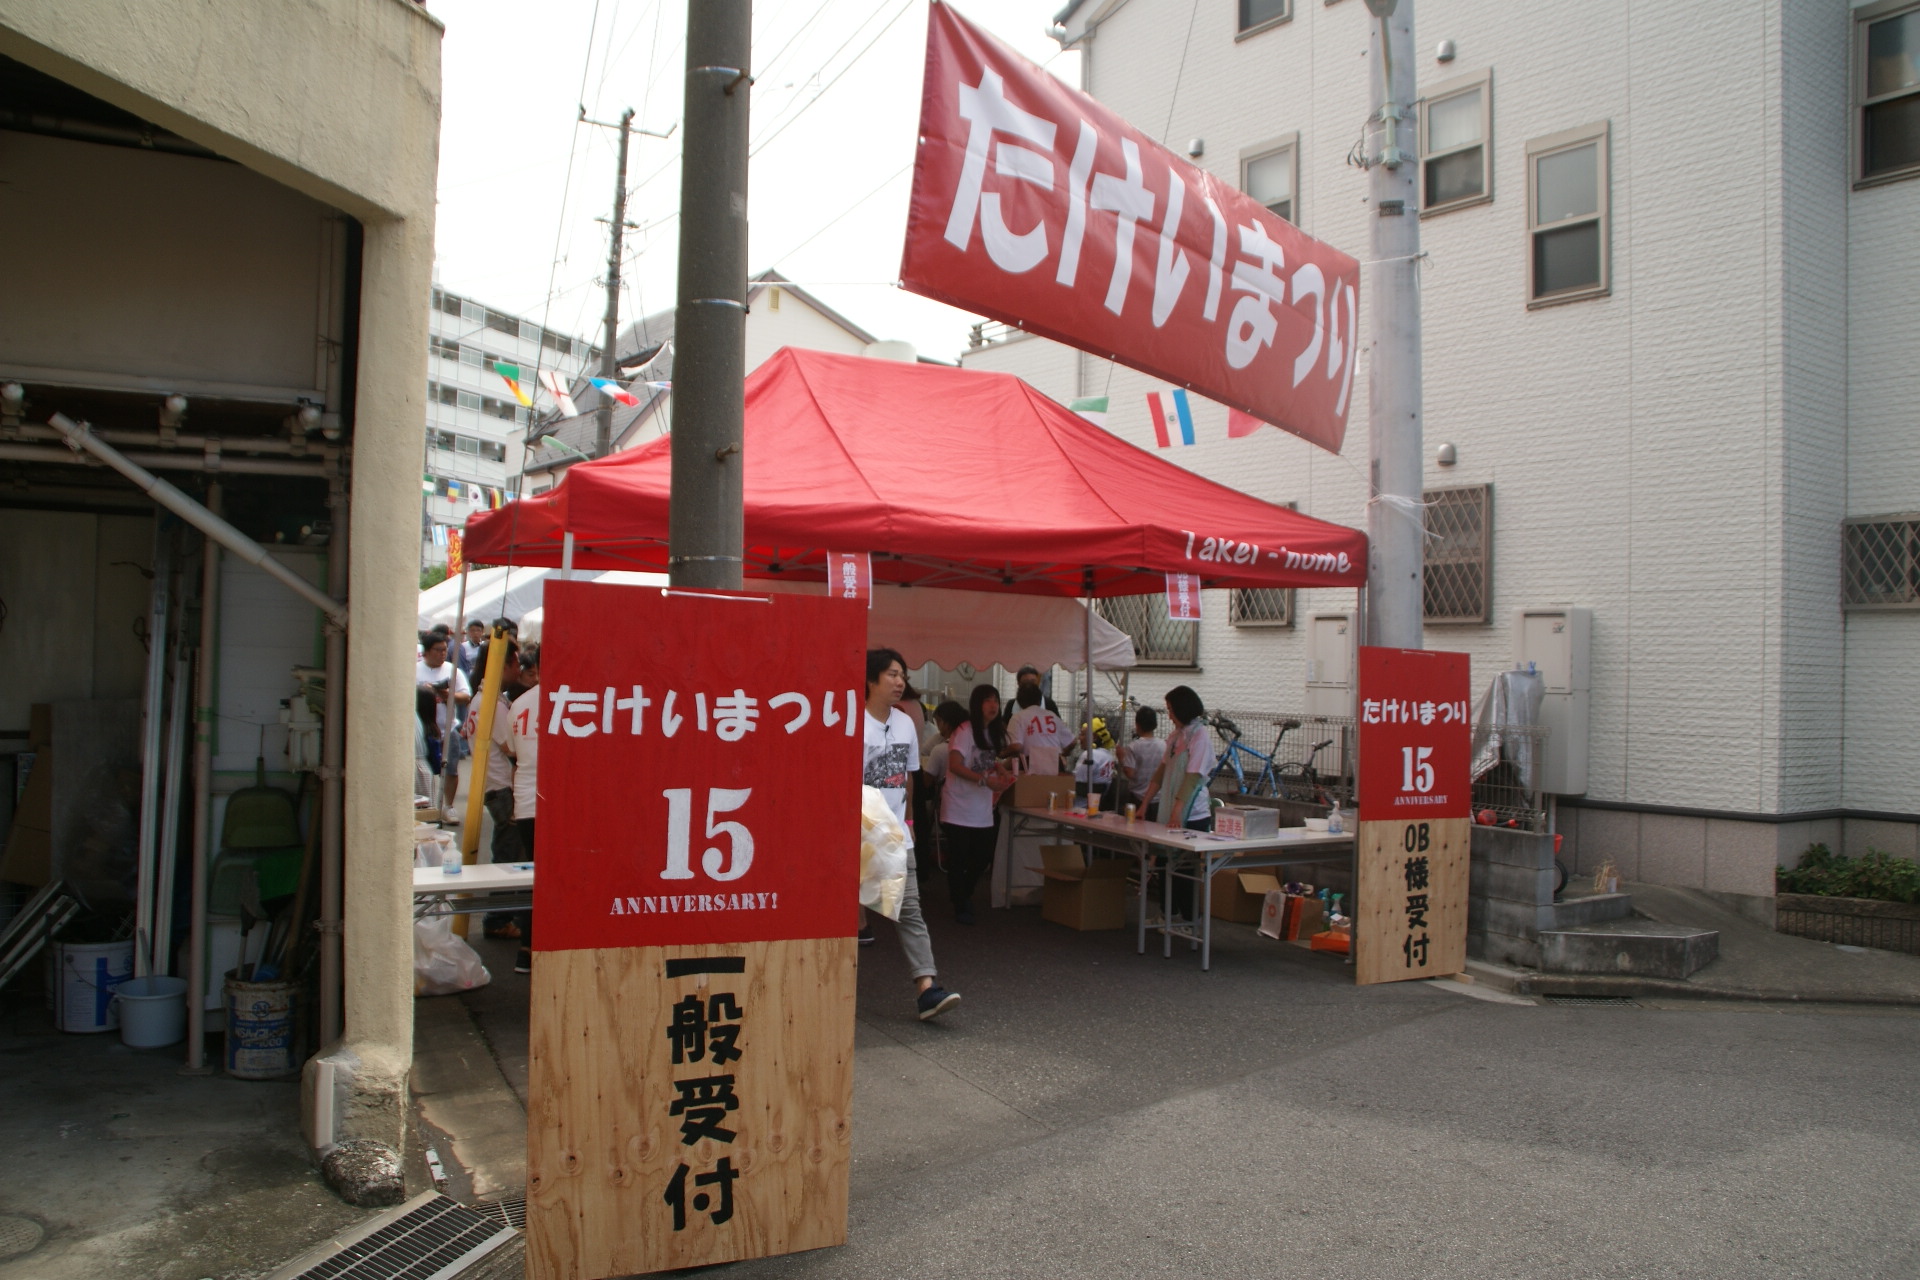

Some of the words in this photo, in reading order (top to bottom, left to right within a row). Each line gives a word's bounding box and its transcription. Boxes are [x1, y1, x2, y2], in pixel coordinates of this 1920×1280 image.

[944, 64, 1355, 417] たけいまつり
[513, 708, 540, 736] #1
[548, 684, 857, 742] たけいまつり
[1026, 715, 1057, 737] #15
[1362, 697, 1468, 726] たけいまつり
[1401, 746, 1435, 793] 15
[659, 787, 755, 882] 15
[609, 892, 778, 915] ANNIVERSARY!
[1403, 822, 1431, 968] OB様受付
[663, 955, 746, 1232] 一般受付
